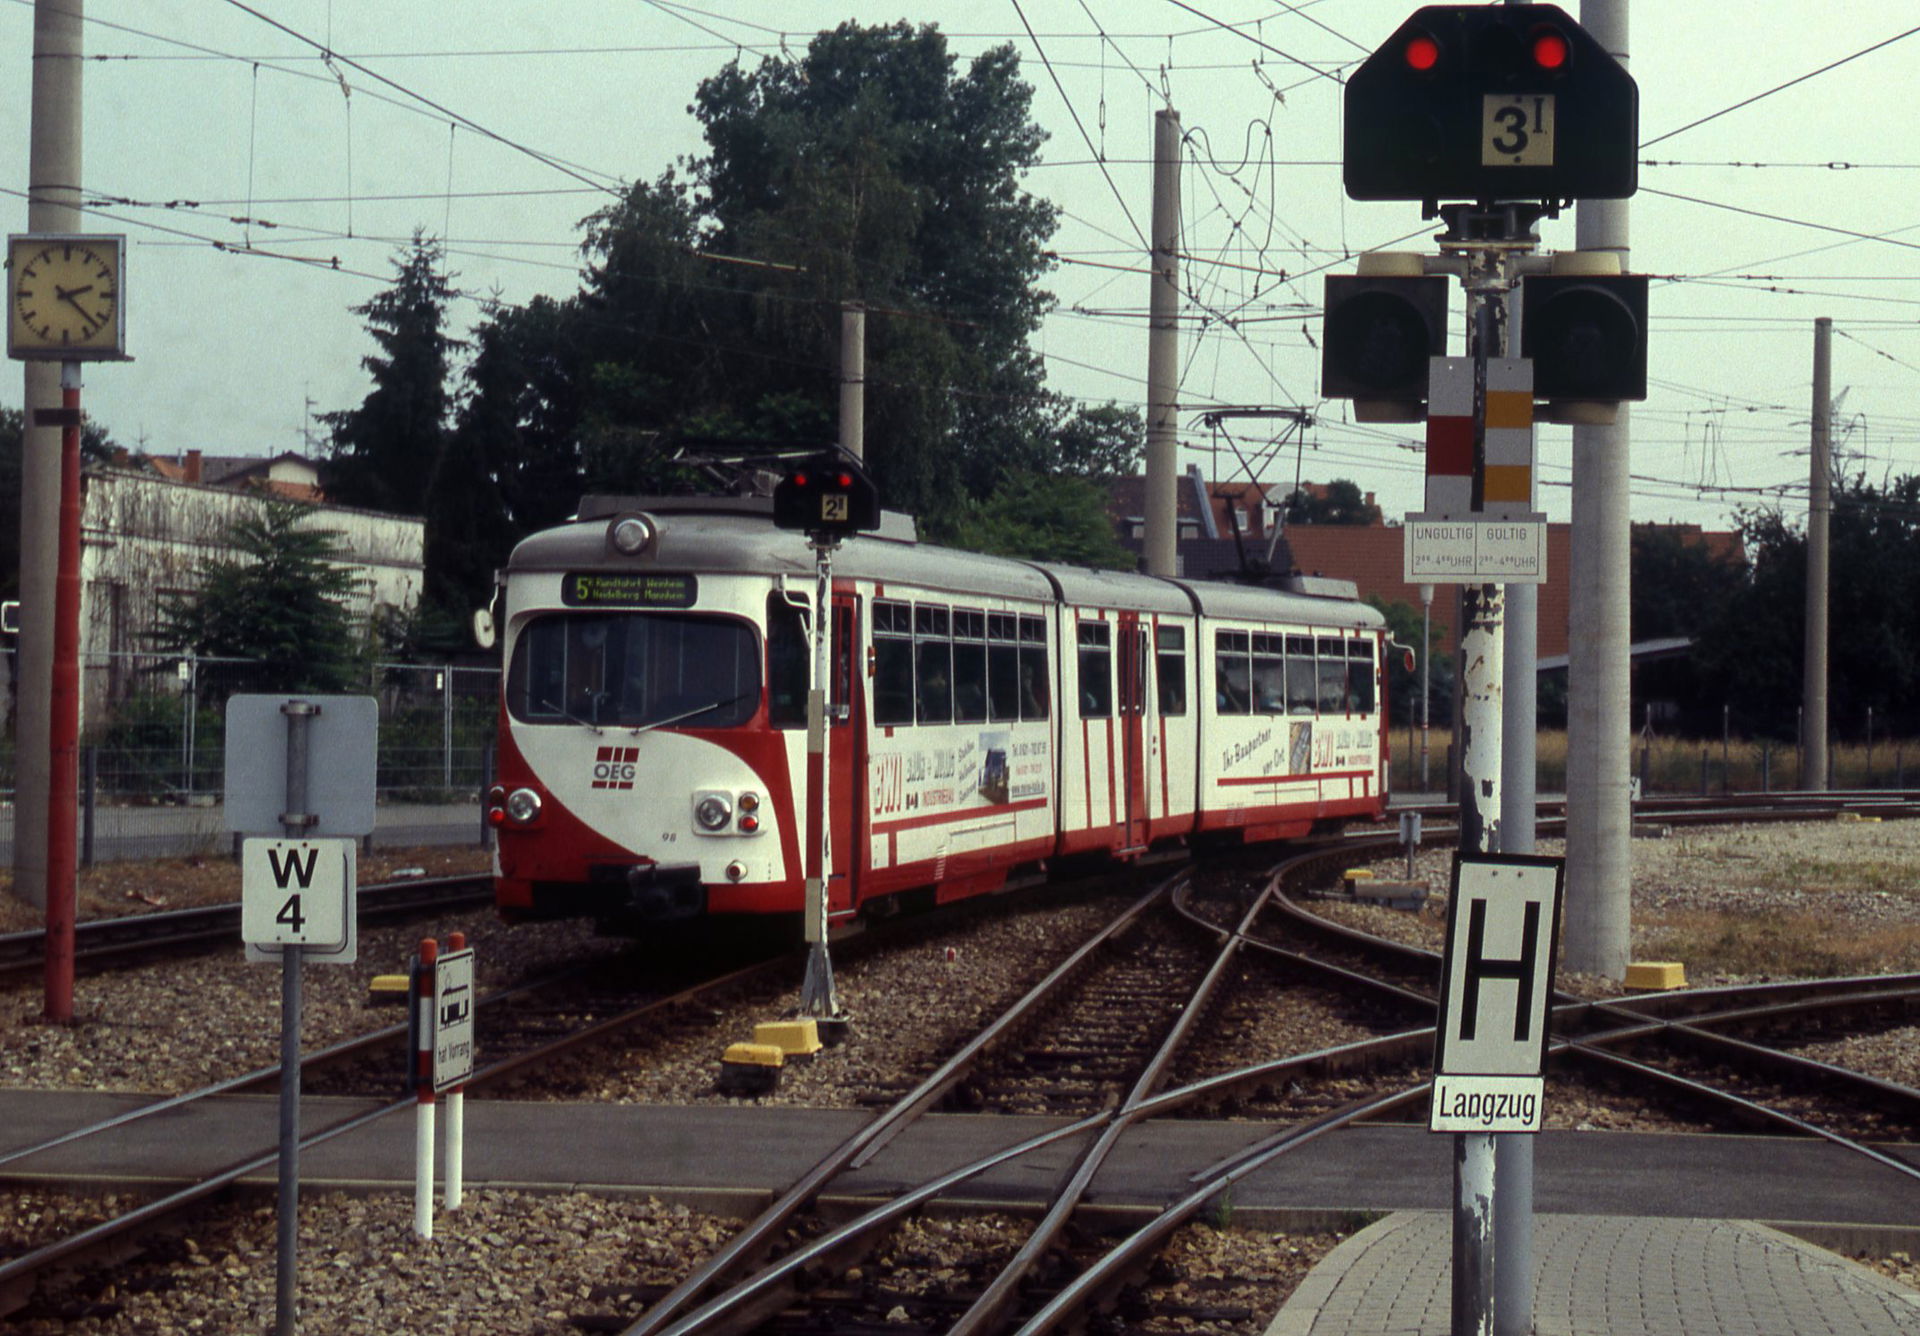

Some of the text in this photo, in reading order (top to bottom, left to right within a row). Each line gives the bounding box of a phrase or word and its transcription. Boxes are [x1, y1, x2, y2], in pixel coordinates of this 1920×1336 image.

[593, 763, 636, 780] OEG
[267, 848, 319, 889] W
[276, 893, 306, 934] 4
[1459, 898, 1541, 1042] H
[1439, 1085, 1537, 1126] Langzug
